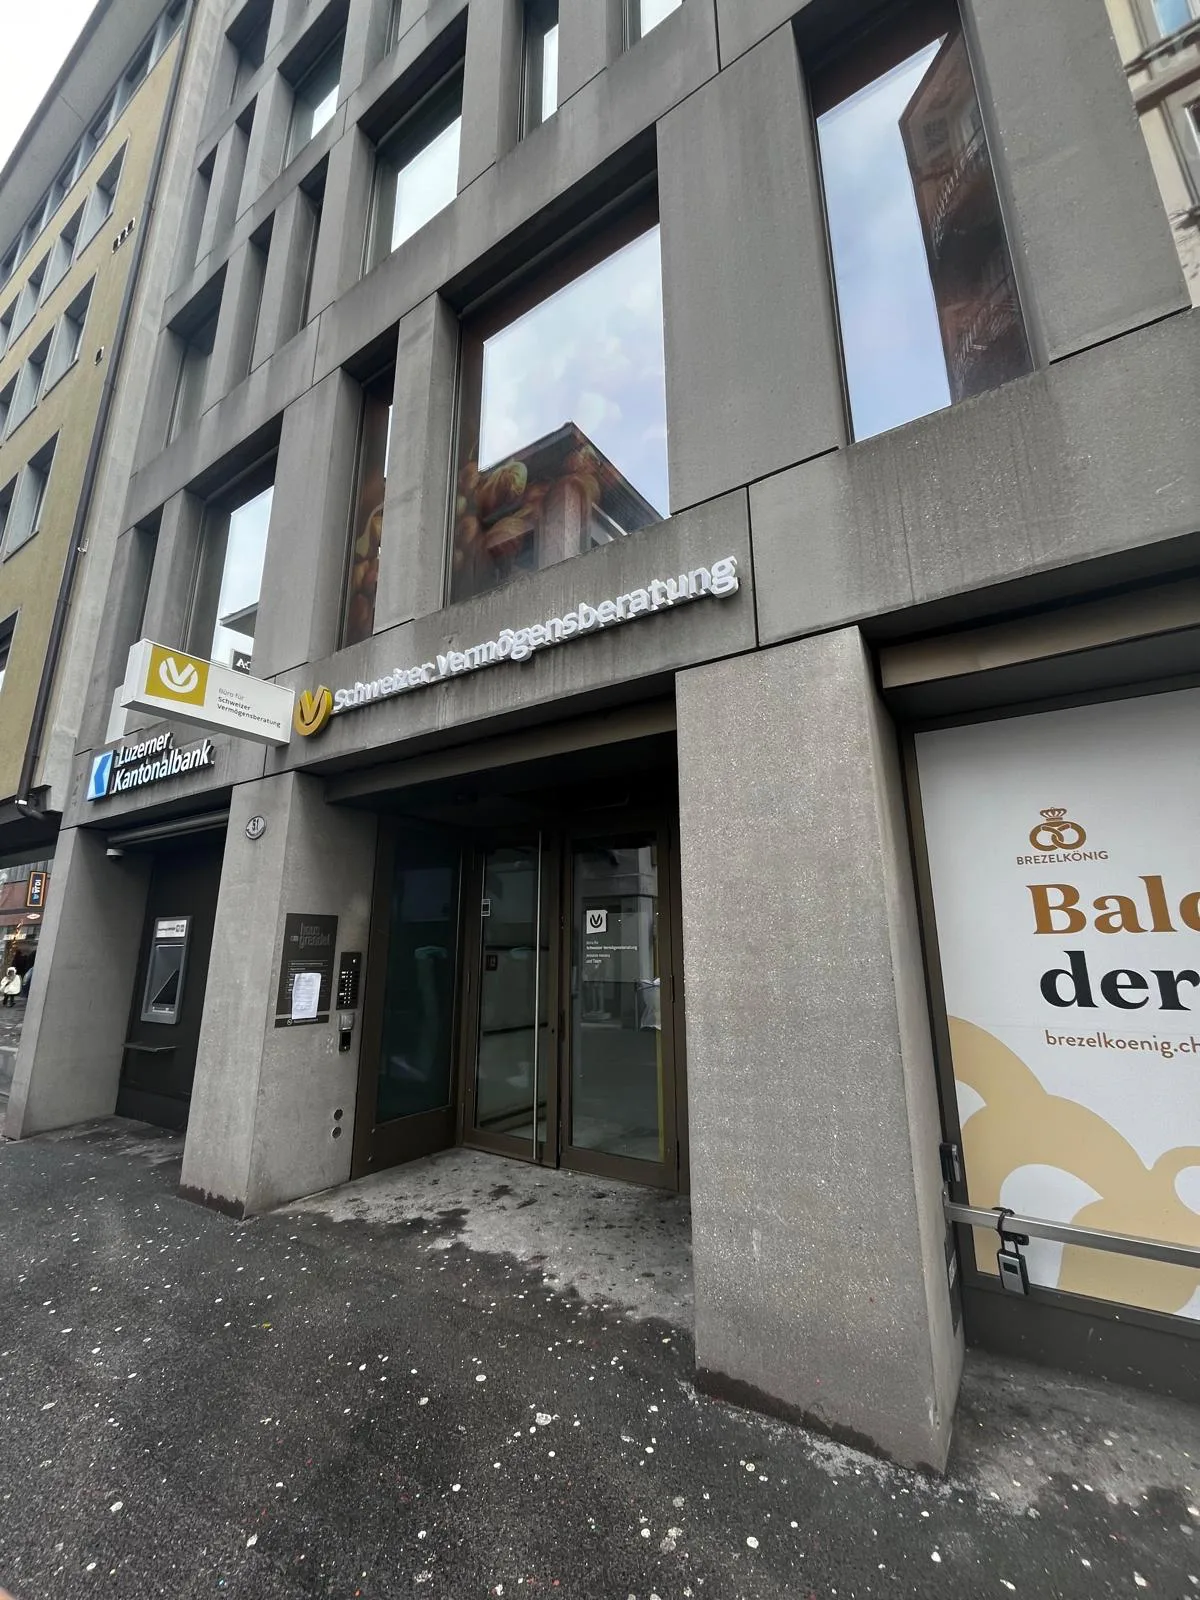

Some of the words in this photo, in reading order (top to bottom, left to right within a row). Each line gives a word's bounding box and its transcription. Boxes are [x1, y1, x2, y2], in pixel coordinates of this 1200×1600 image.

[333, 662, 435, 713] Schweizer
[436, 554, 738, 677] Vermögensberatung
[217, 696, 251, 711] Schweizer
[218, 687, 234, 698] Büro
[216, 703, 281, 728] Vermögensberatung
[118, 731, 173, 766] Luzerner
[112, 738, 213, 792] Kantonalbank
[1016, 850, 1109, 865] BREZELKÖNIG
[1040, 950, 1200, 1011] der
